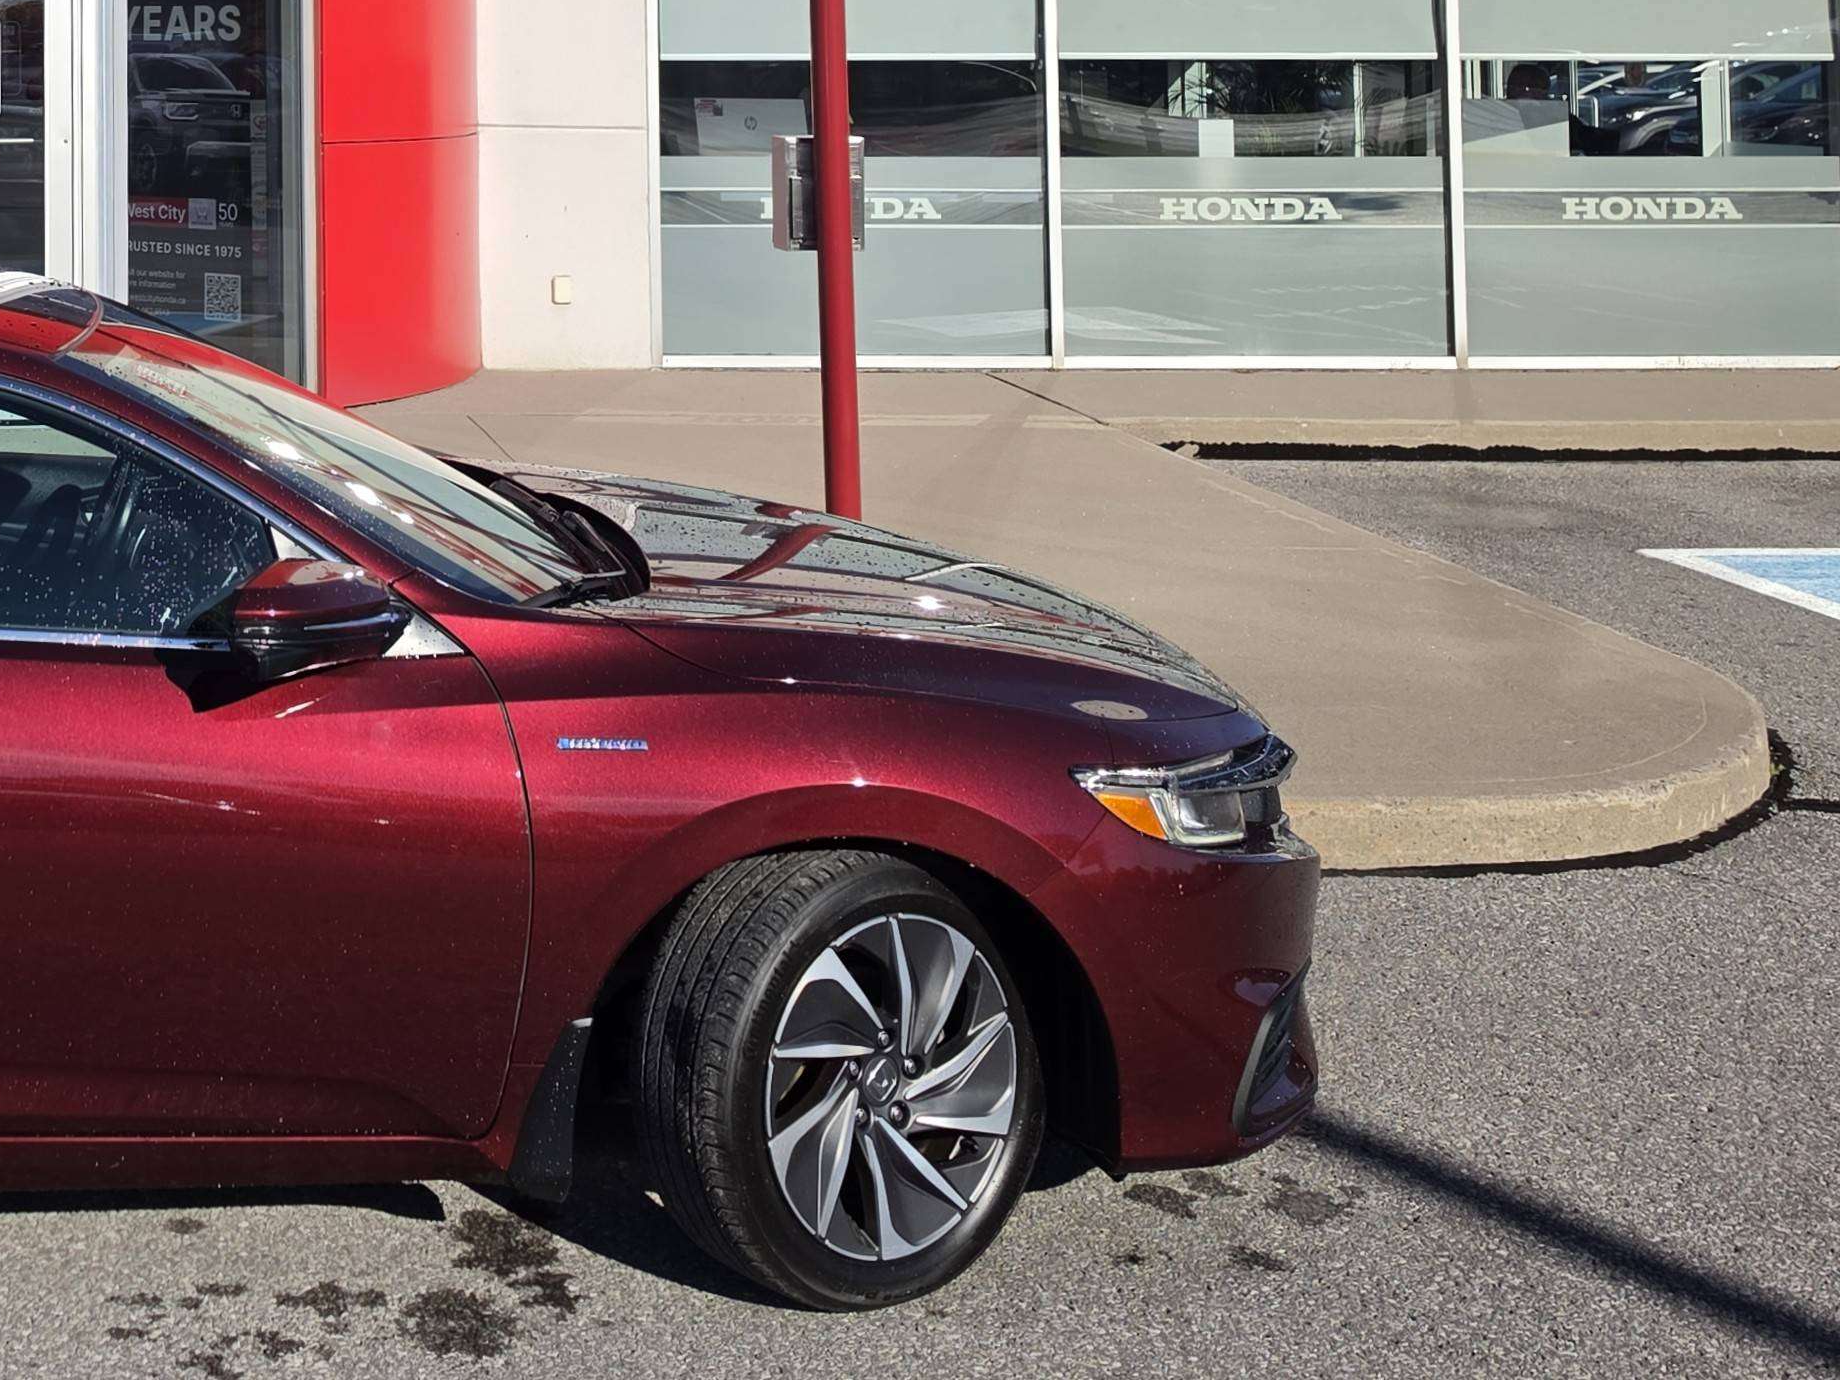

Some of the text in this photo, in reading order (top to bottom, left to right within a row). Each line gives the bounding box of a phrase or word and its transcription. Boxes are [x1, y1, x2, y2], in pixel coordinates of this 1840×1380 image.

[158, 204, 187, 223] City
[218, 202, 238, 221] 50
[1160, 196, 1342, 220] HONDA
[1561, 196, 1743, 220] HONDA
[128, 240, 242, 258] RUSTED SINCE 1975
